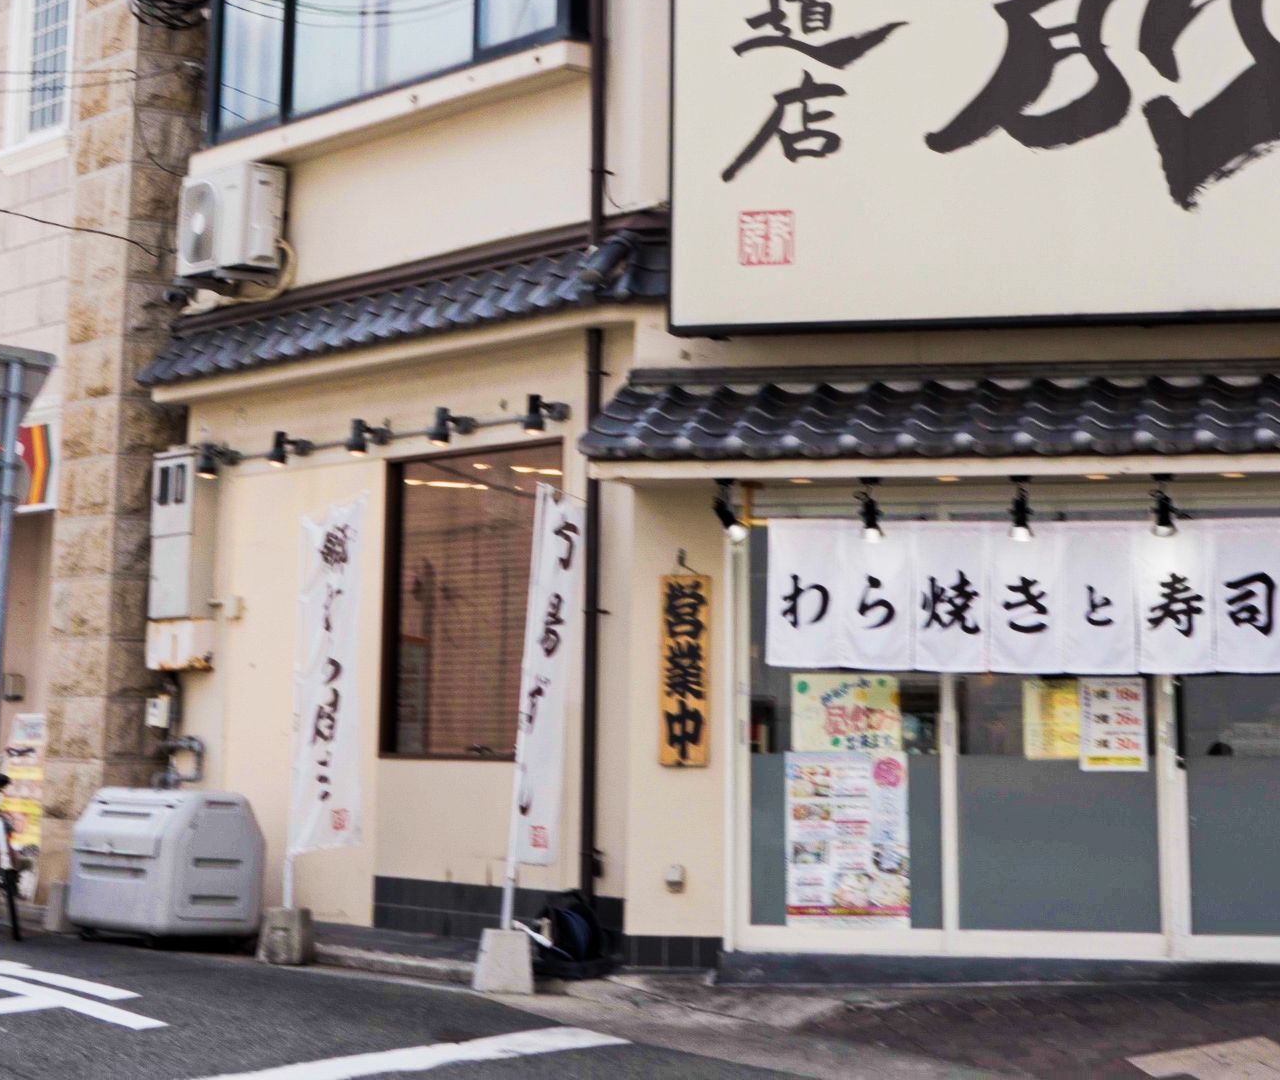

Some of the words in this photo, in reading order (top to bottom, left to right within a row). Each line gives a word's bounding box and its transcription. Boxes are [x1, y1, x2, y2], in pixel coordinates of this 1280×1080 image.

[780, 569, 1278, 638] わら焼きと寿司
[663, 578, 708, 760] 営業中
